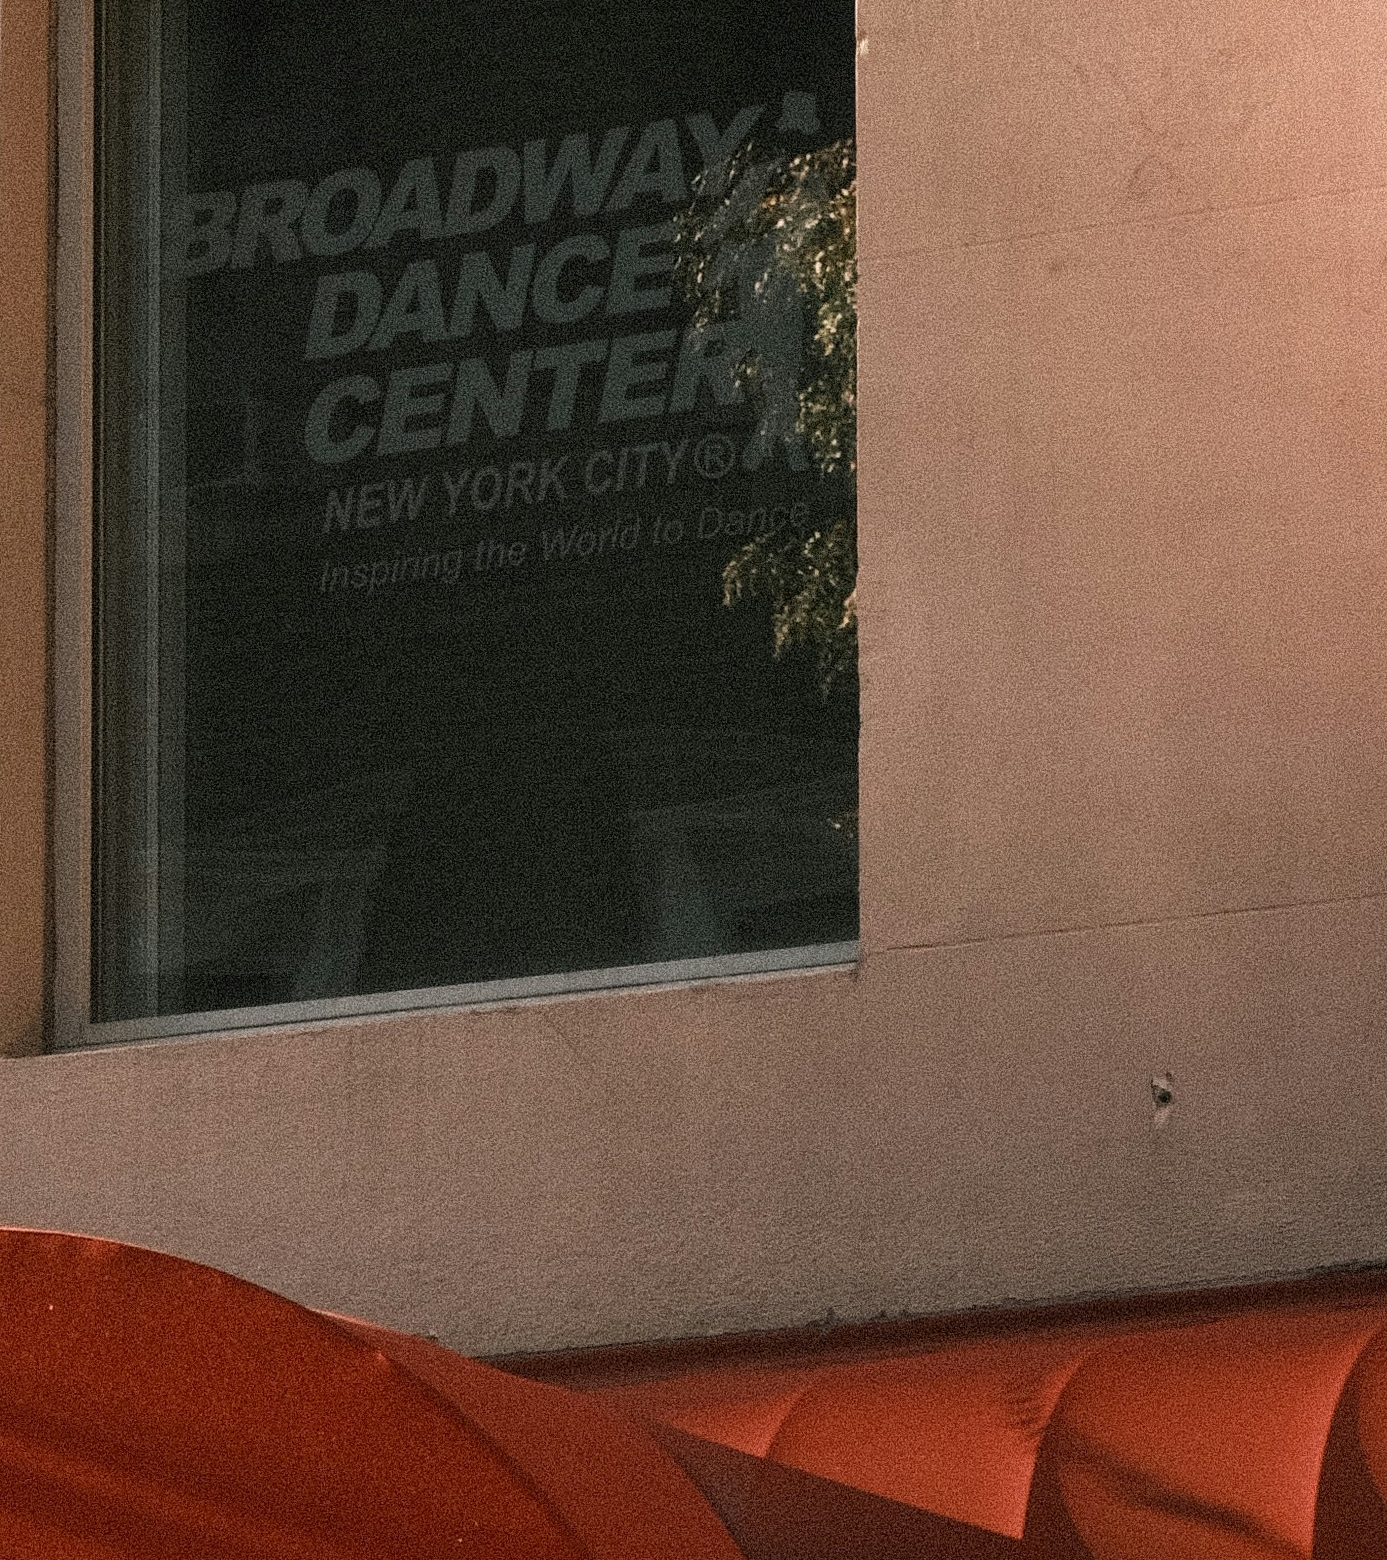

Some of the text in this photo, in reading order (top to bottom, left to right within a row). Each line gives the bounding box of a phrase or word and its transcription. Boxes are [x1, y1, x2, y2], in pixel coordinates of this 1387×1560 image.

[169, 104, 767, 278] BROADWAY
[305, 222, 682, 361] DANCE
[304, 316, 747, 466] CENTER
[320, 543, 463, 594] Inspiring
[473, 527, 526, 570] the
[541, 509, 645, 561] World
[651, 512, 685, 547] to
[322, 478, 432, 535] NEW
[443, 462, 570, 519] YORK
